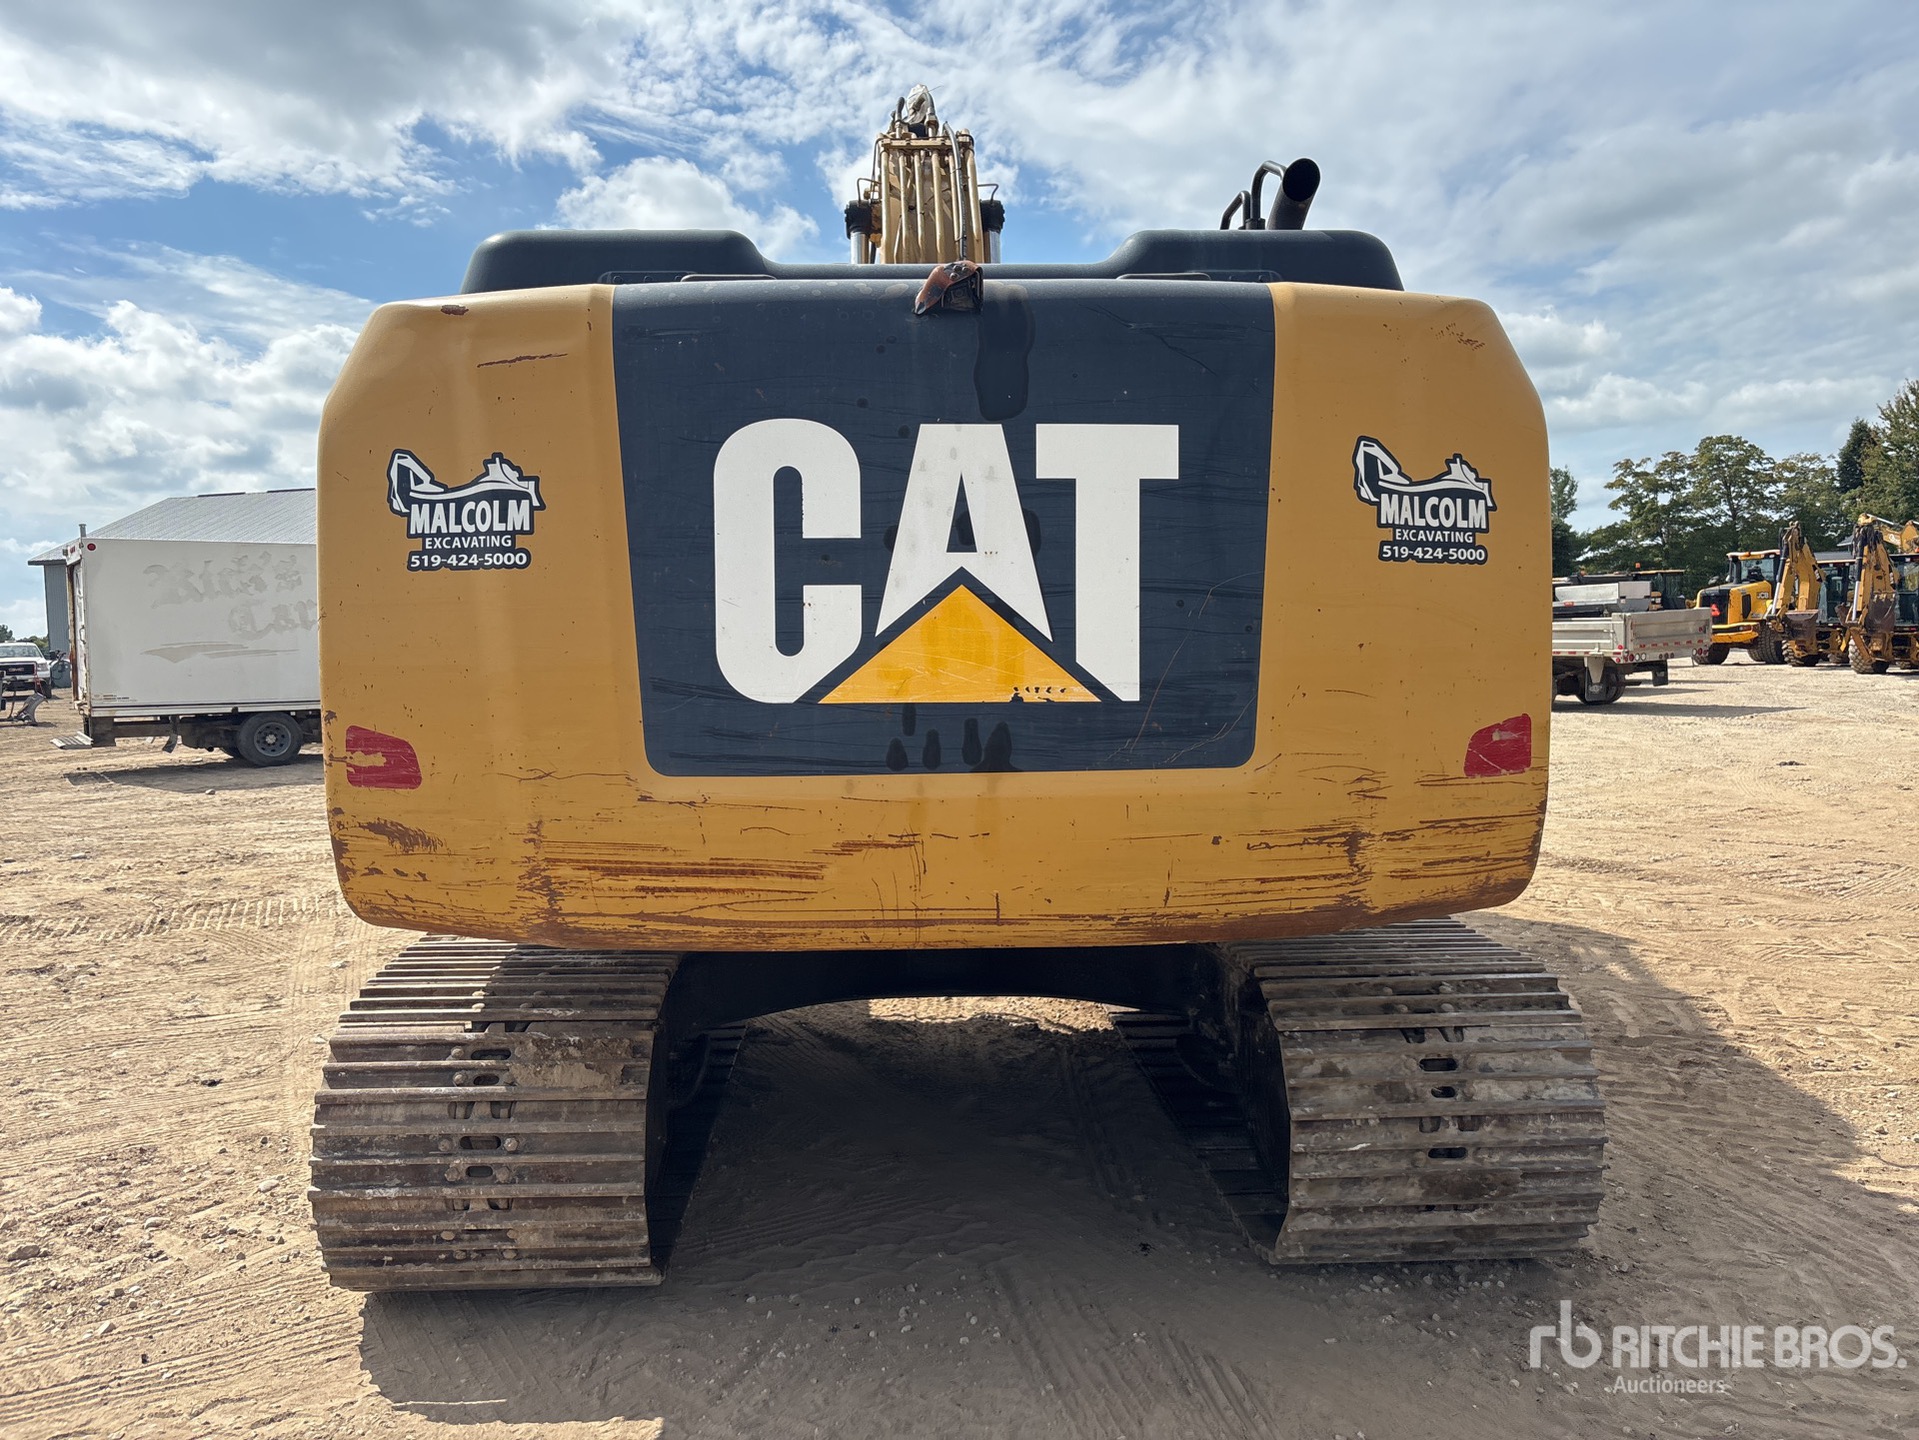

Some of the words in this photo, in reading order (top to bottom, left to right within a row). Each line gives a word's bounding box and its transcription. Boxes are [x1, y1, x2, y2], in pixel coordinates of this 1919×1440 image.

[409, 499, 531, 535] MALCOLM
[1380, 493, 1487, 530] MALCOLM
[424, 534, 513, 550] EXCAVATING
[1395, 528, 1474, 543] EXCAVATING
[410, 552, 528, 568] 519-424-5000
[1382, 545, 1486, 561] 519-424-5000
[713, 418, 1180, 705] CAT
